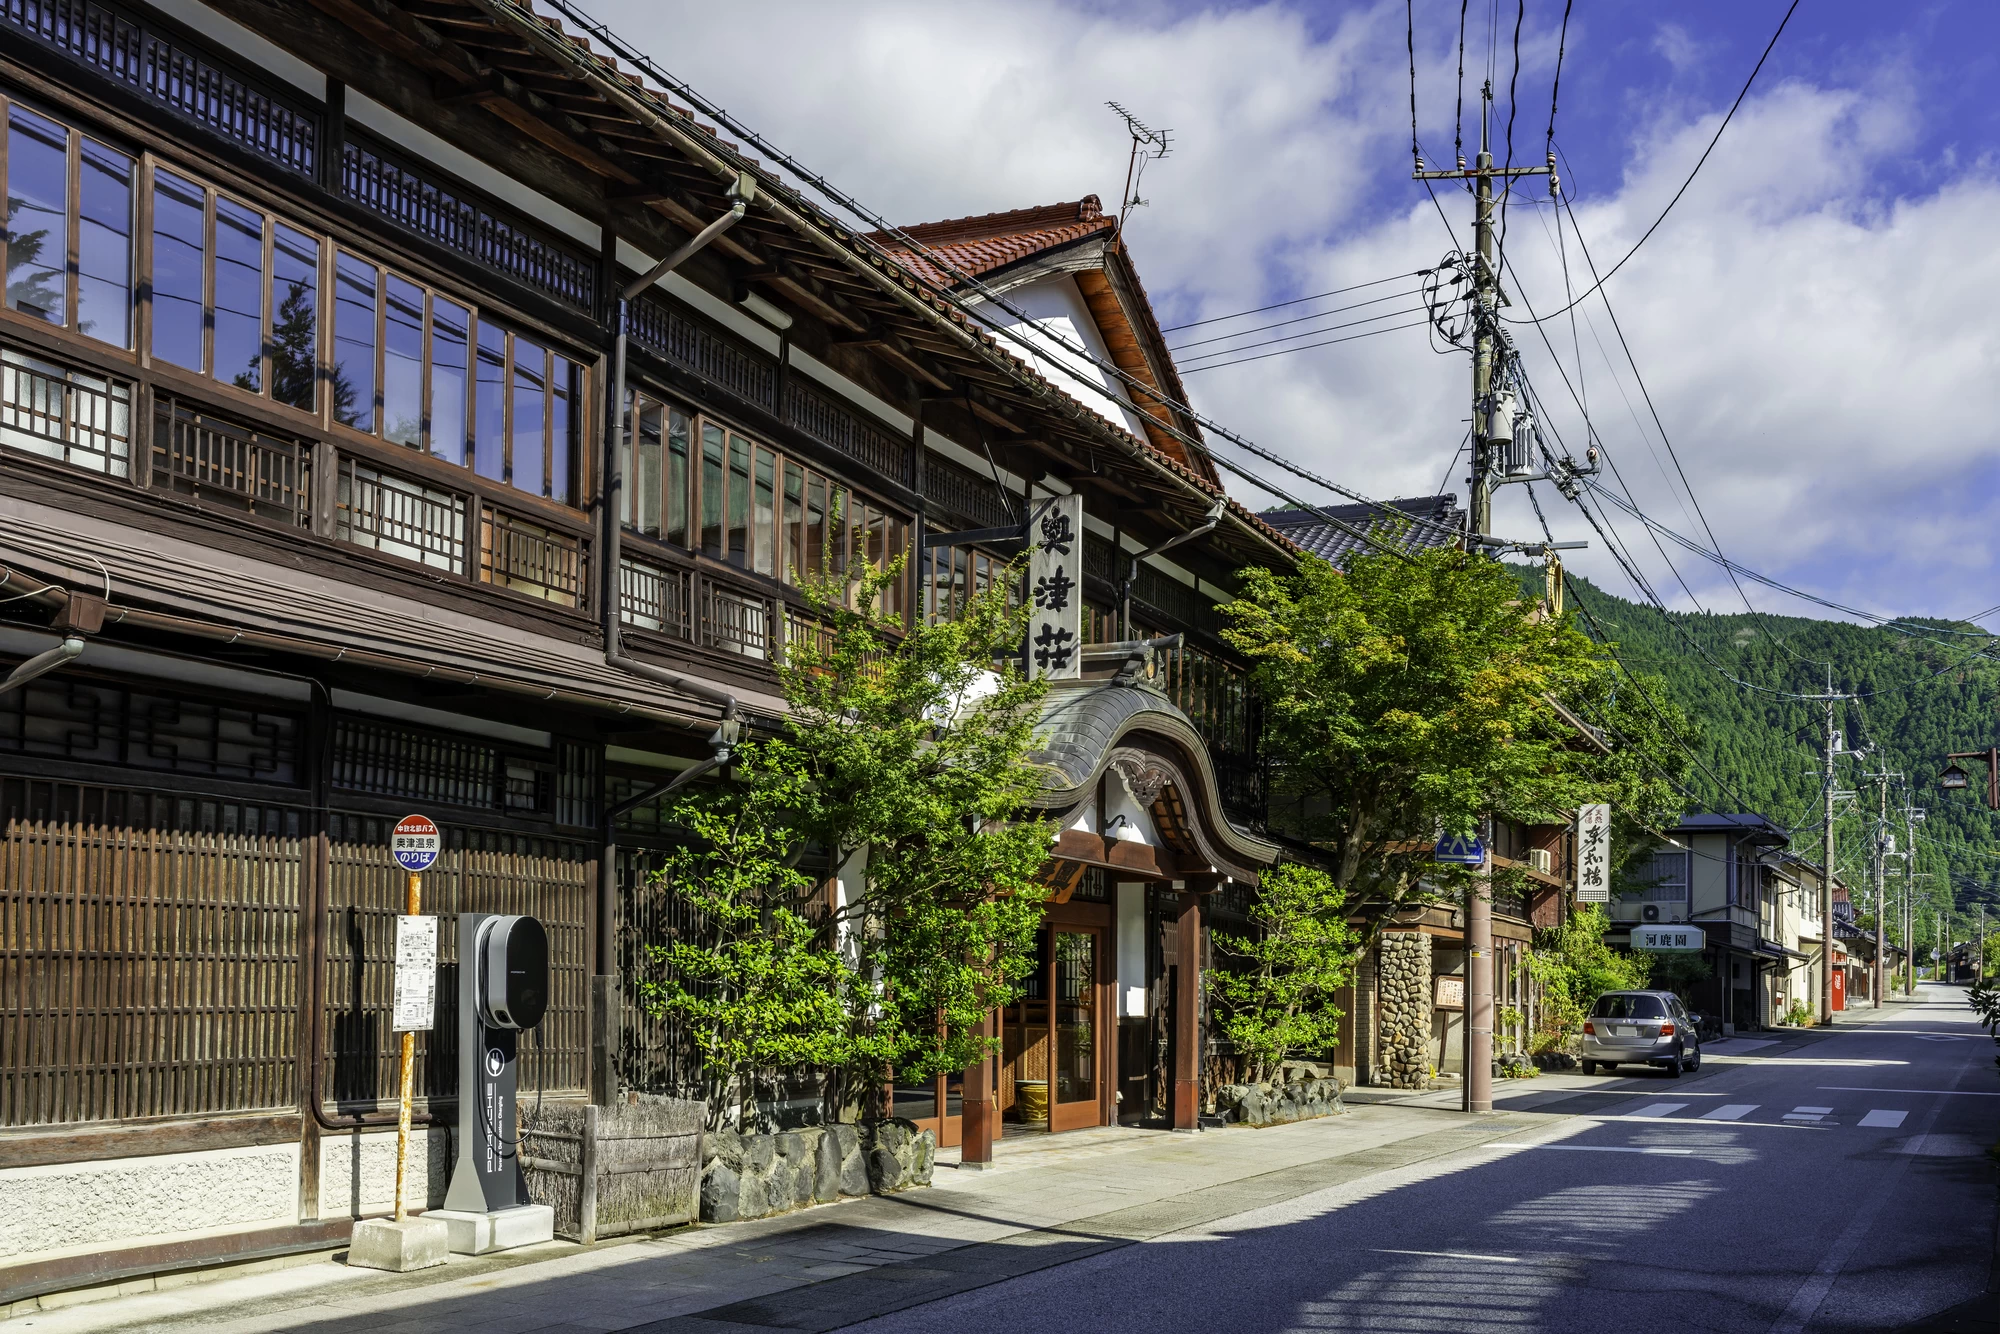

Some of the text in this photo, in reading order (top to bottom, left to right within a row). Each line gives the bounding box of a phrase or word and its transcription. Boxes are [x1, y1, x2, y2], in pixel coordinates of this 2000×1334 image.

[396, 837, 436, 849] 奥津温泉
[400, 852, 431, 864] のりば
[1645, 933, 1687, 947] 河鹿園
